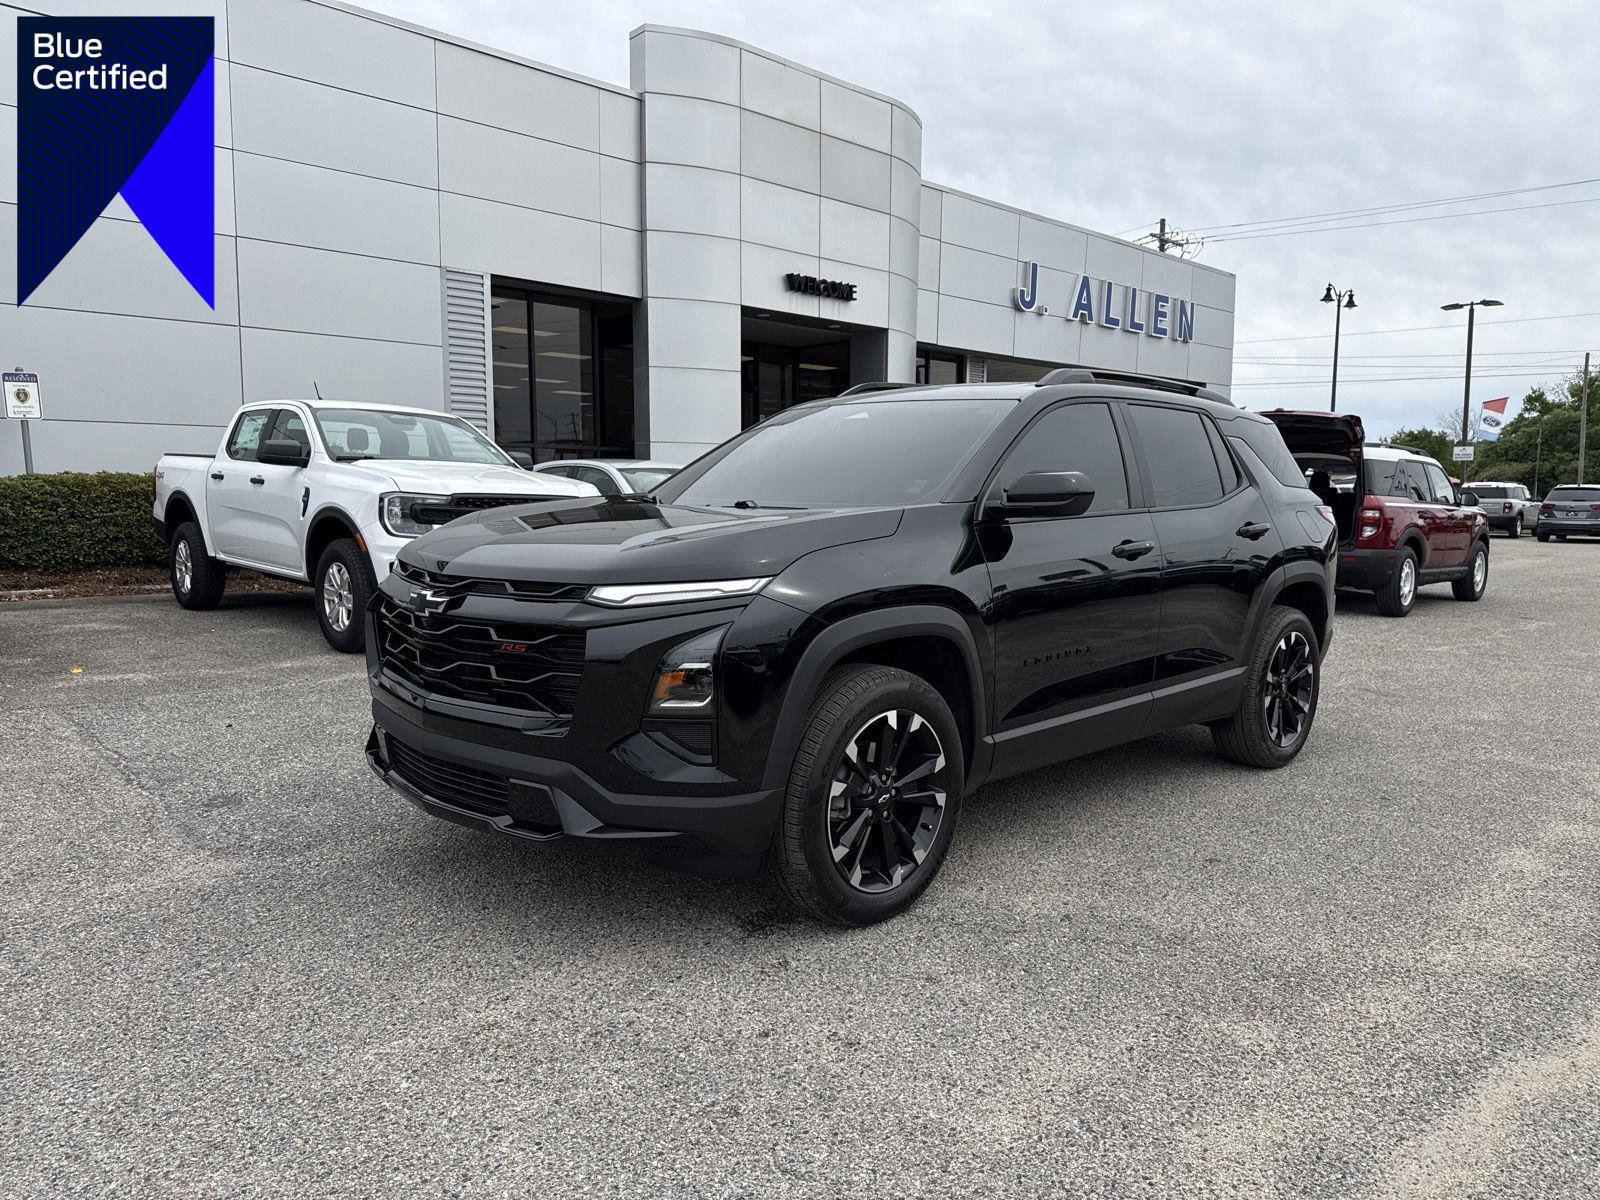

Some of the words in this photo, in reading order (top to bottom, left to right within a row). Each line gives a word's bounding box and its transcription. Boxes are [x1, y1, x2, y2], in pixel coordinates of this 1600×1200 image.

[784, 273, 858, 302] WELCOME
[1014, 261, 1049, 315] J.
[1067, 274, 1195, 343] ALLEN
[500, 642, 527, 652] RS
